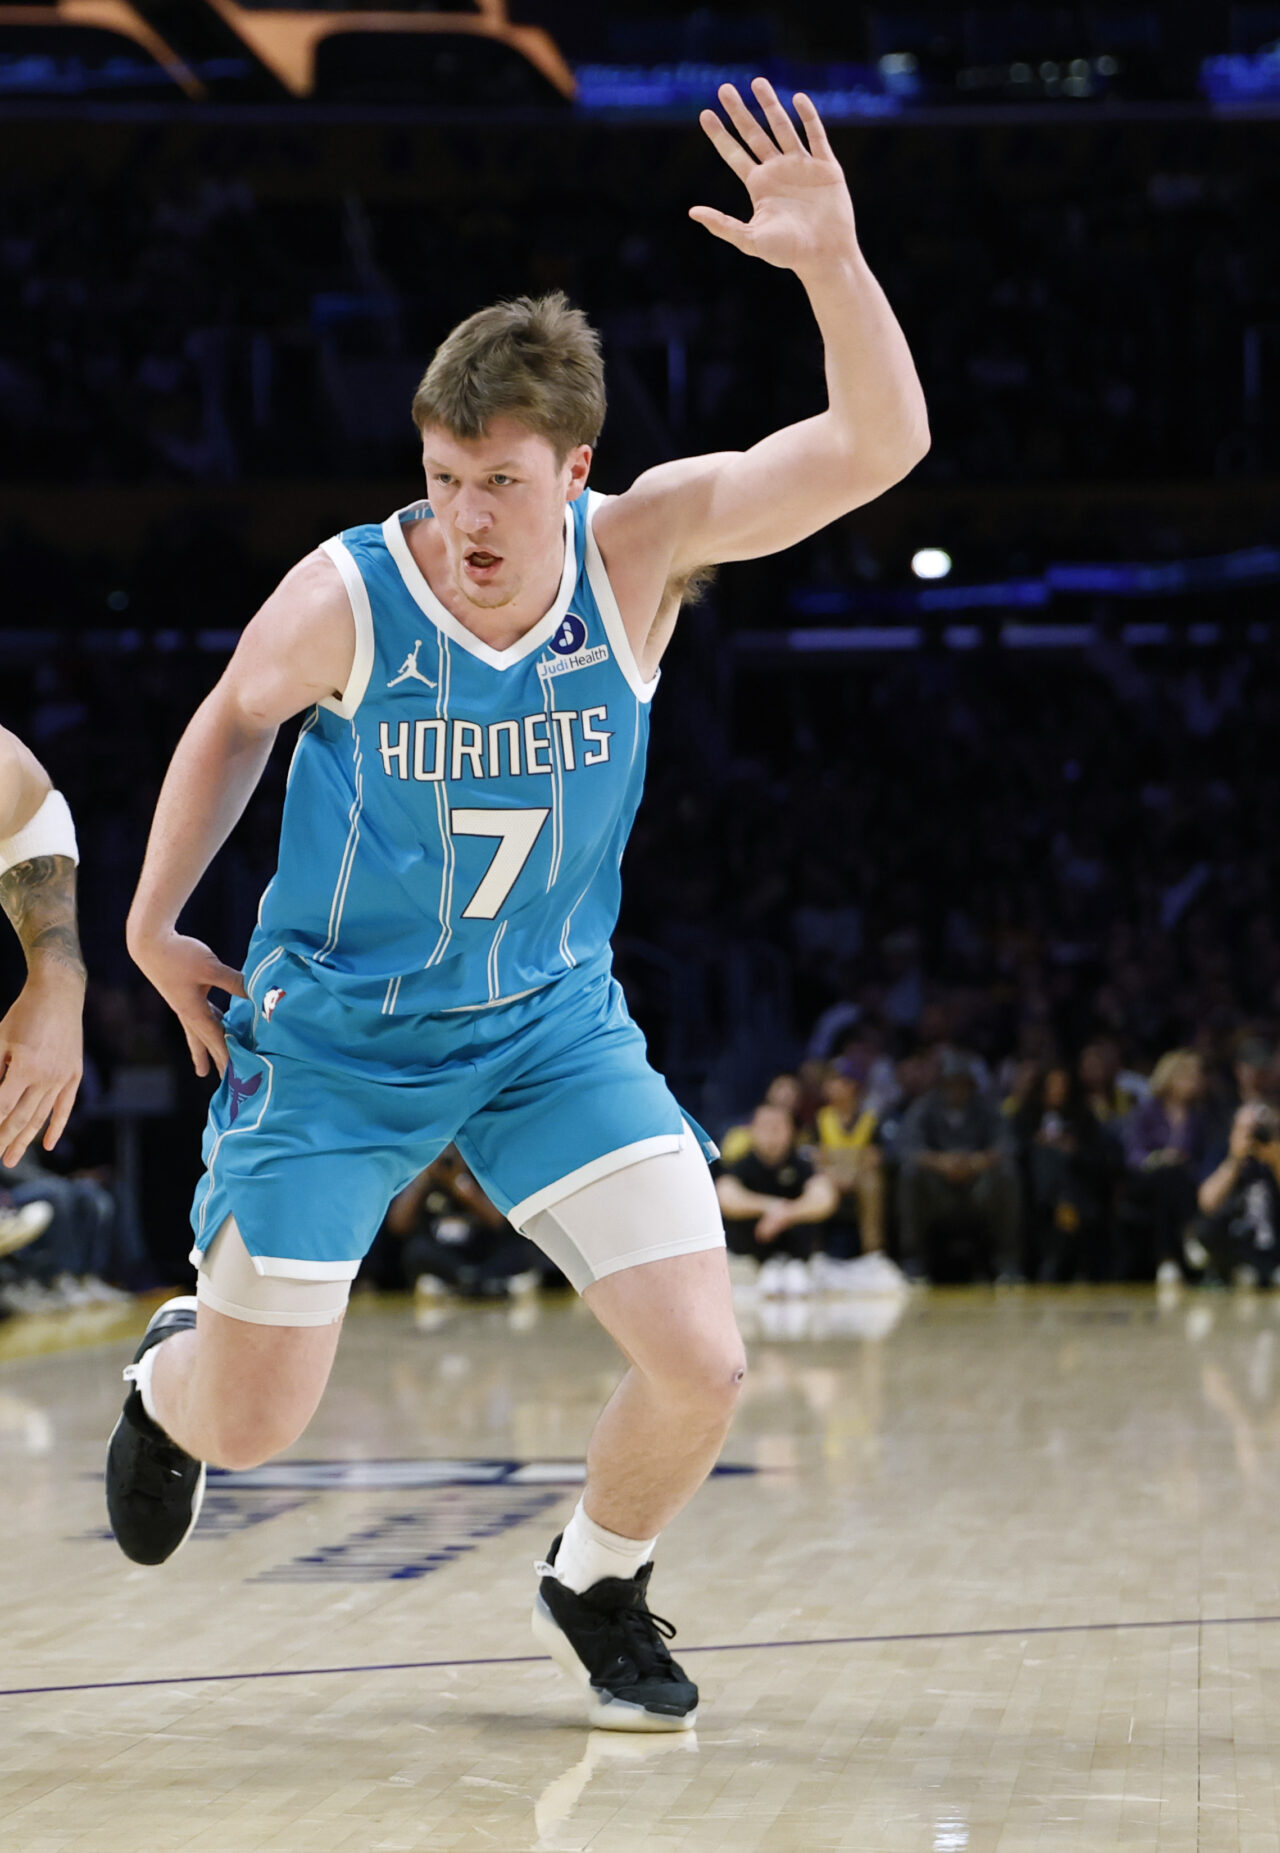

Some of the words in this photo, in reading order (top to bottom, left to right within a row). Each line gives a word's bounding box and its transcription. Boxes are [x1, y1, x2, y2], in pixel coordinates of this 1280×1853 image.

[541, 659, 568, 677] Judi
[569, 649, 607, 669] Health
[377, 704, 615, 782] HORNETS
[450, 807, 552, 920] 7
